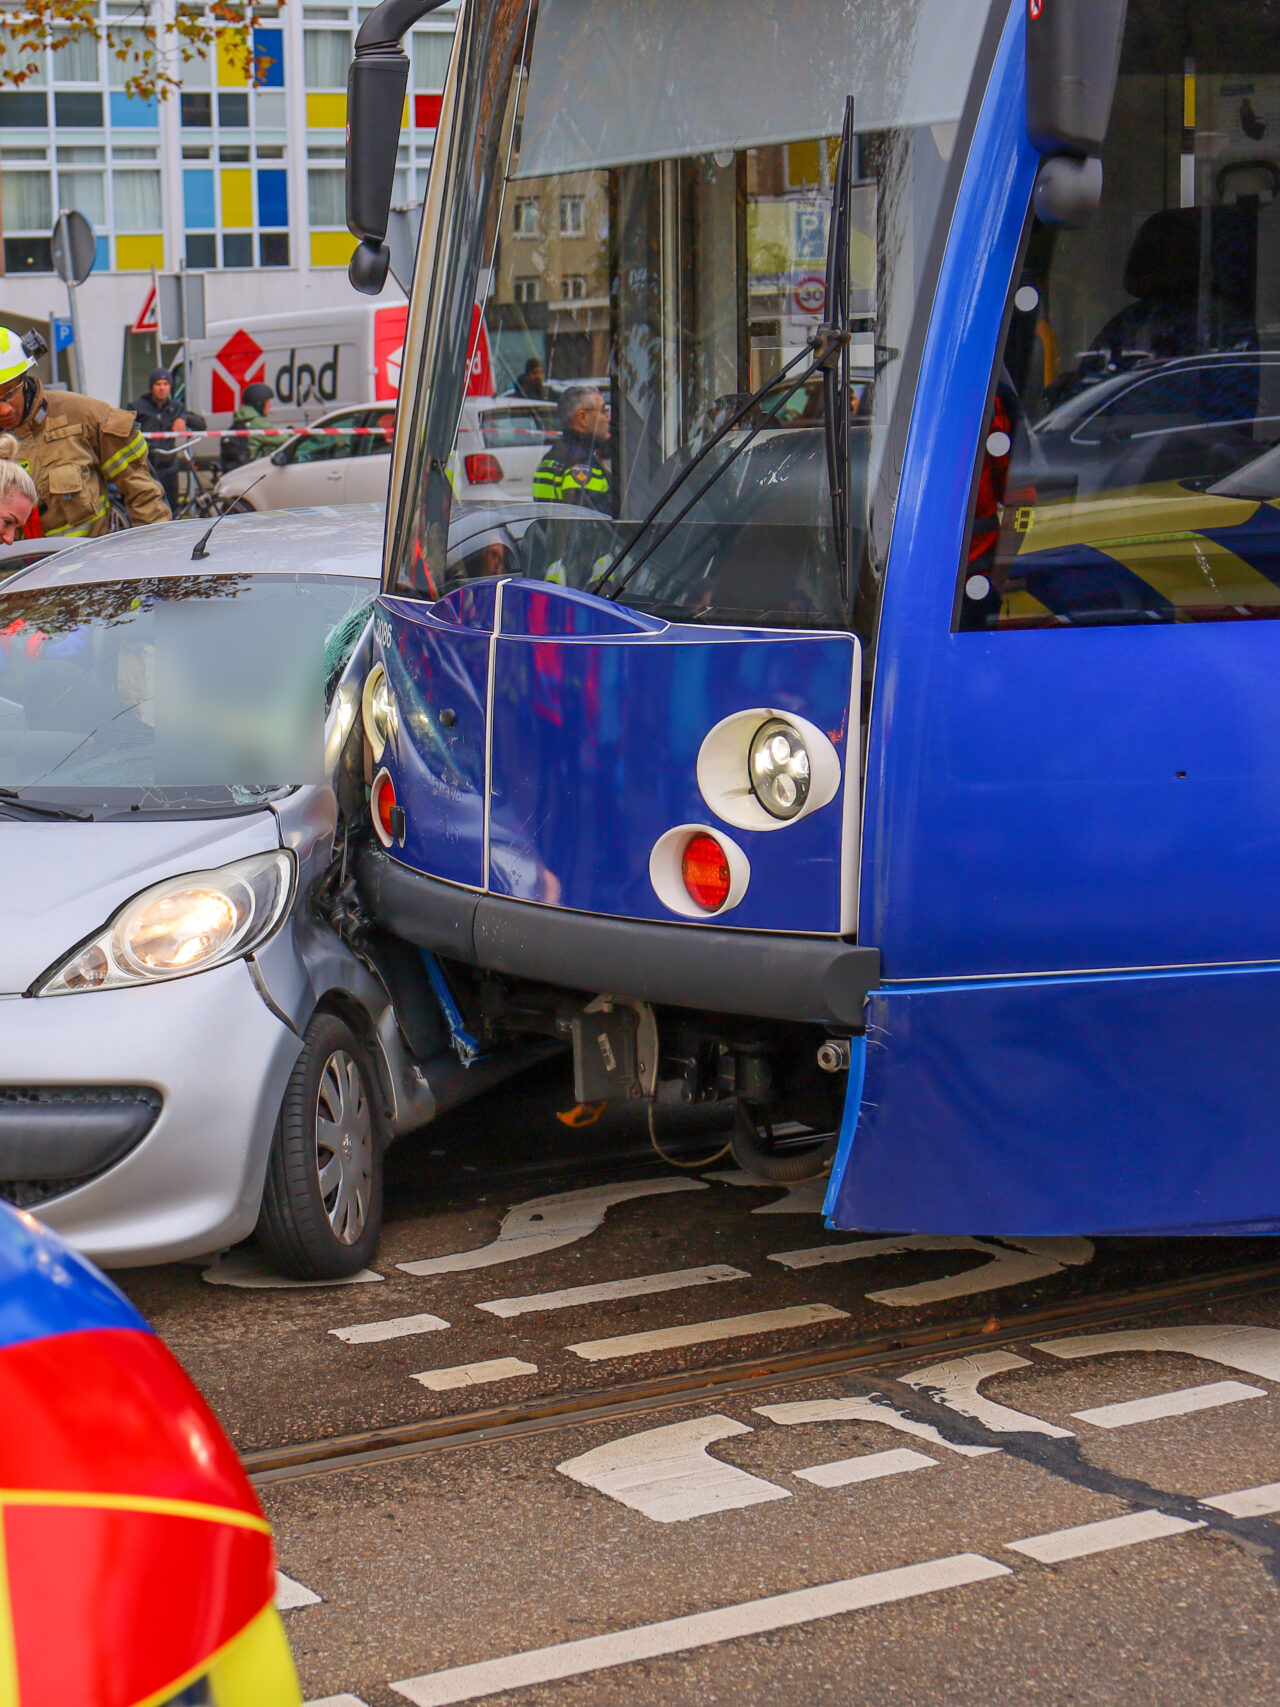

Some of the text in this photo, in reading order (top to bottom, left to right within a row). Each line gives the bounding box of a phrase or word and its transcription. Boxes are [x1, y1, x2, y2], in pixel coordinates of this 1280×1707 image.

[801, 288, 824, 301] 30
[60, 327, 70, 341] P
[275, 344, 340, 408] dpd
[375, 617, 393, 648] 2086
